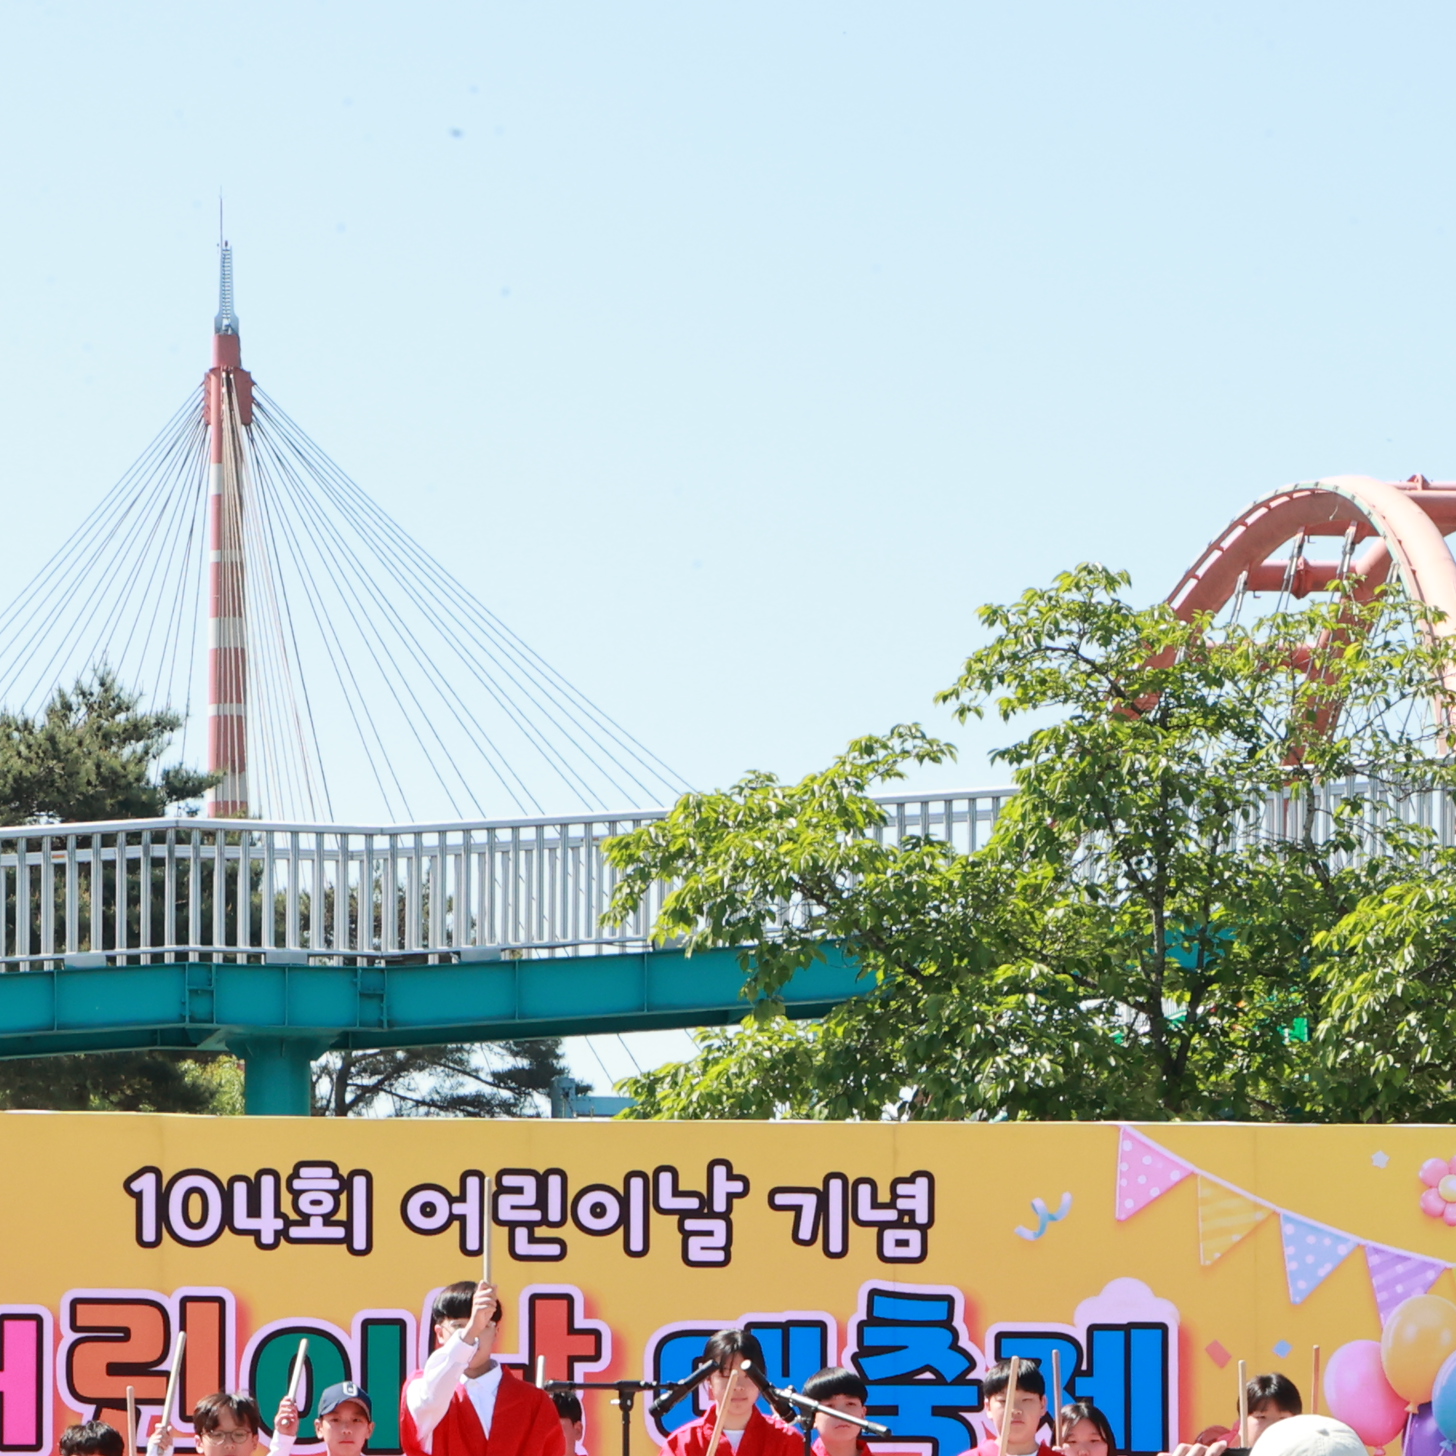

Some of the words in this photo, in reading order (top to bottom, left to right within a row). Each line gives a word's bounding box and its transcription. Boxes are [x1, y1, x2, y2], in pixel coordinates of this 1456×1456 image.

[122, 1160, 373, 1254] 104회
[400, 1159, 750, 1267] 어린이날
[767, 1169, 937, 1263] 기념
